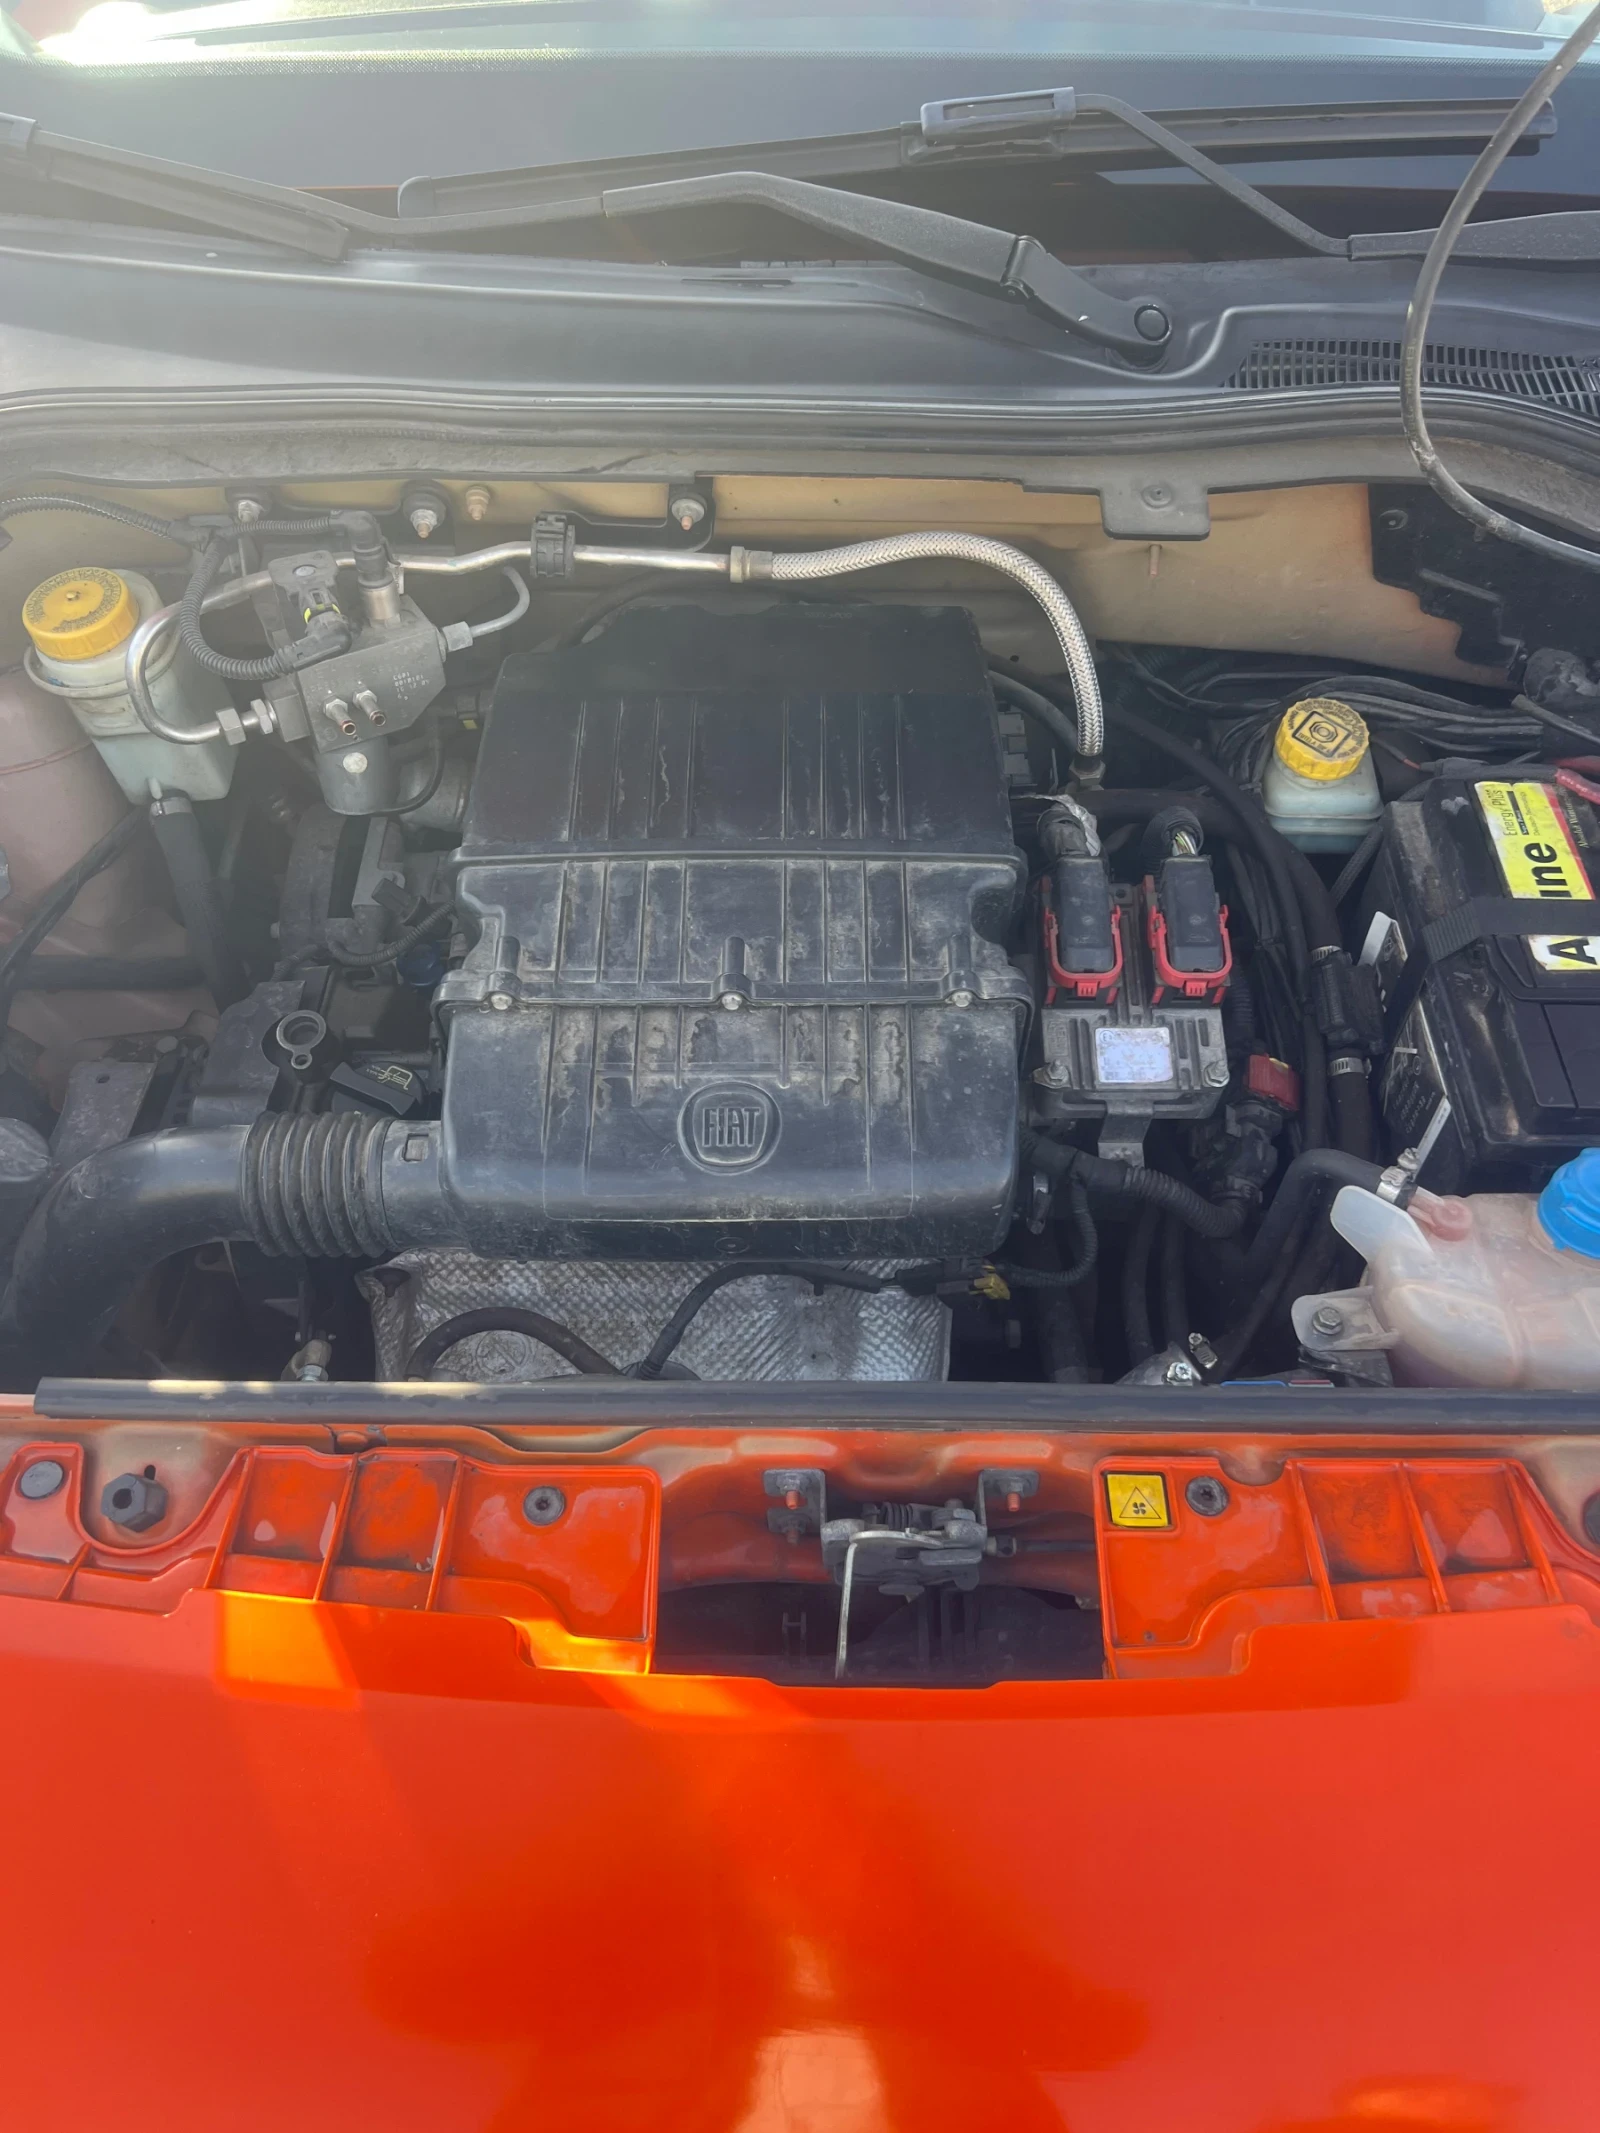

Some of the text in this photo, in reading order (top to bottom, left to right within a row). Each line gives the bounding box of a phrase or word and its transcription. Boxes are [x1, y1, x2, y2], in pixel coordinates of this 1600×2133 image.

[1491, 790, 1518, 836] Energy Plus
[702, 1107, 761, 1147] FIAT
